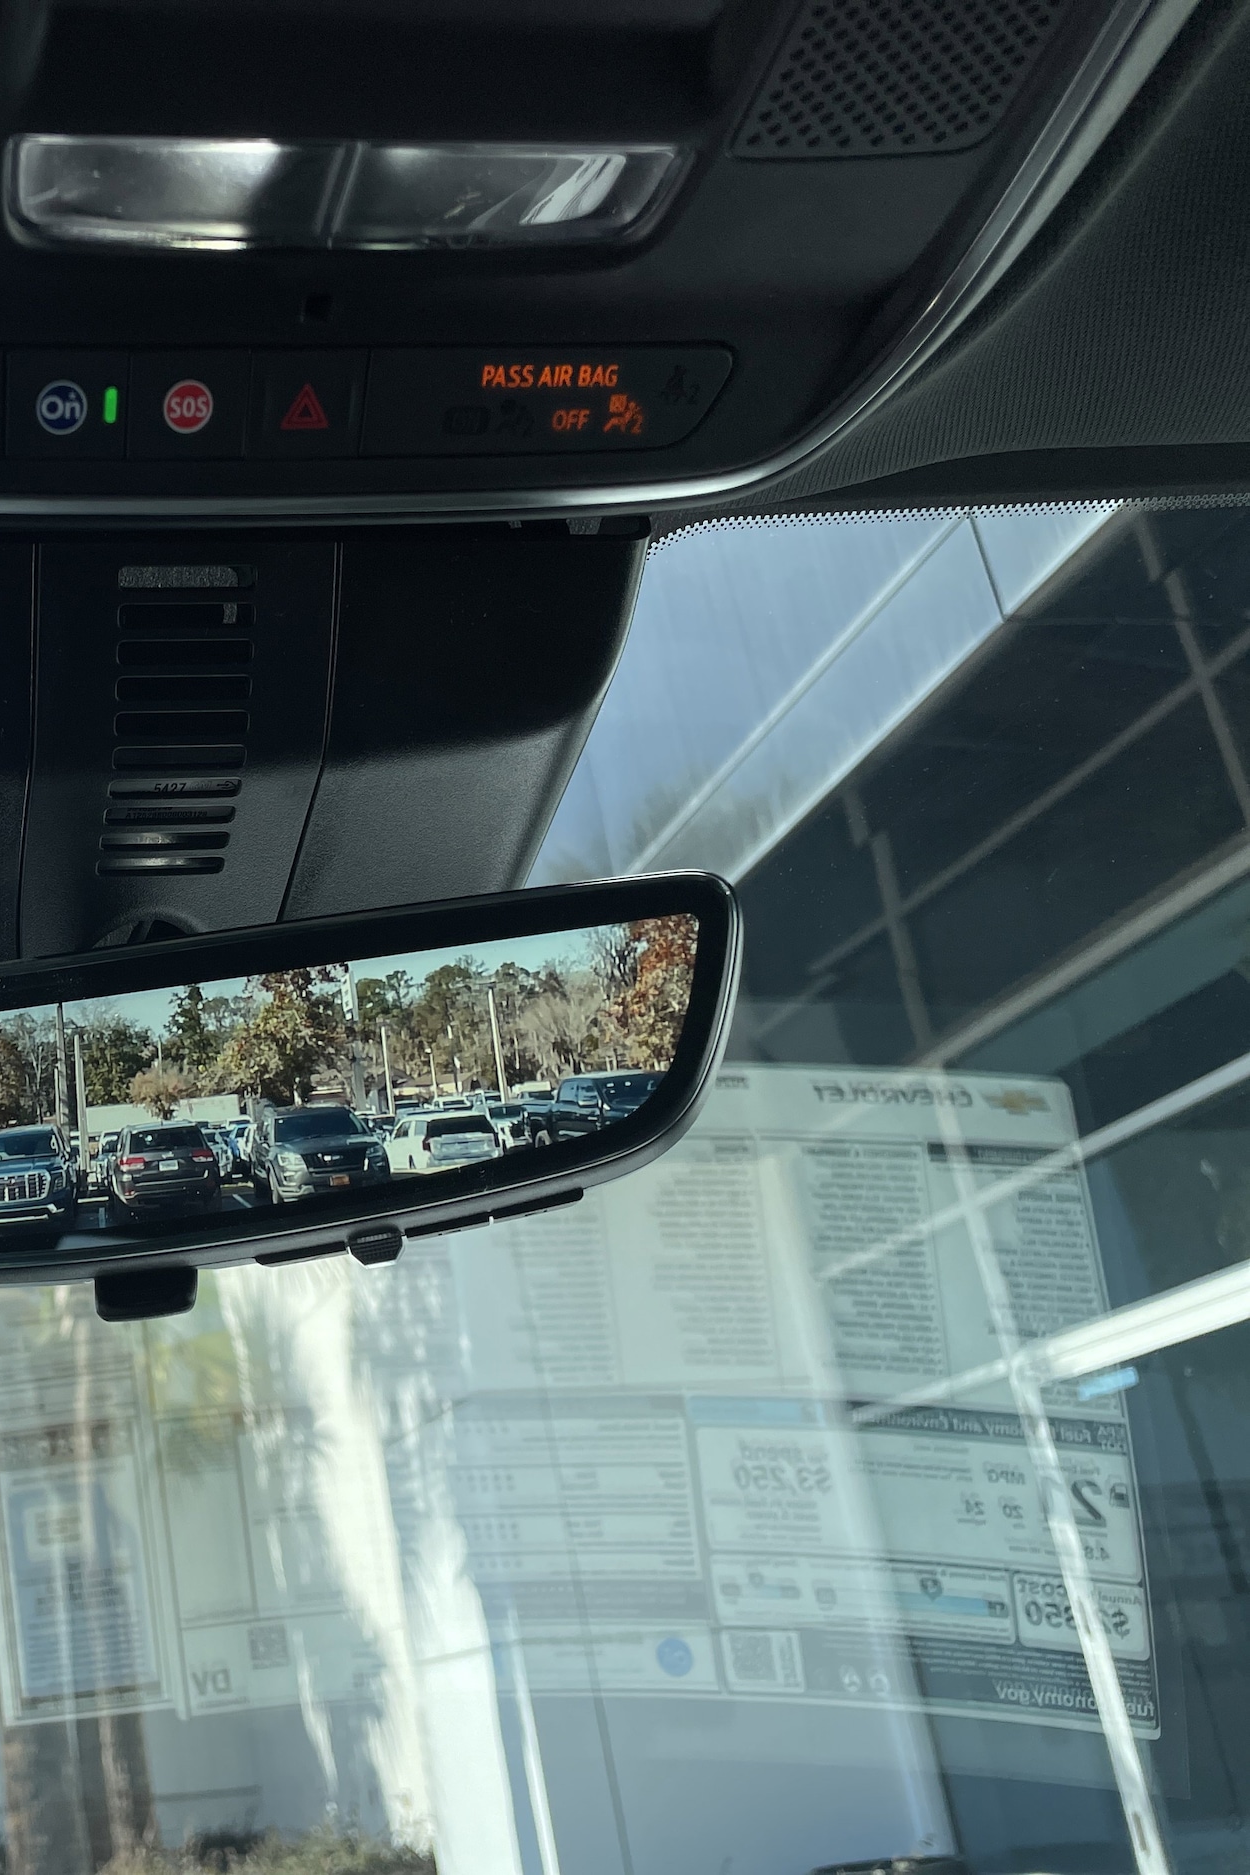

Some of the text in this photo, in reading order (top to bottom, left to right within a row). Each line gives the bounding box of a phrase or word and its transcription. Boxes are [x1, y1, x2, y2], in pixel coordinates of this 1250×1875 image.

[481, 363, 620, 388] PASS AIR BAG
[40, 392, 82, 420] On
[169, 395, 209, 419] SOS
[550, 409, 591, 431] OFF
